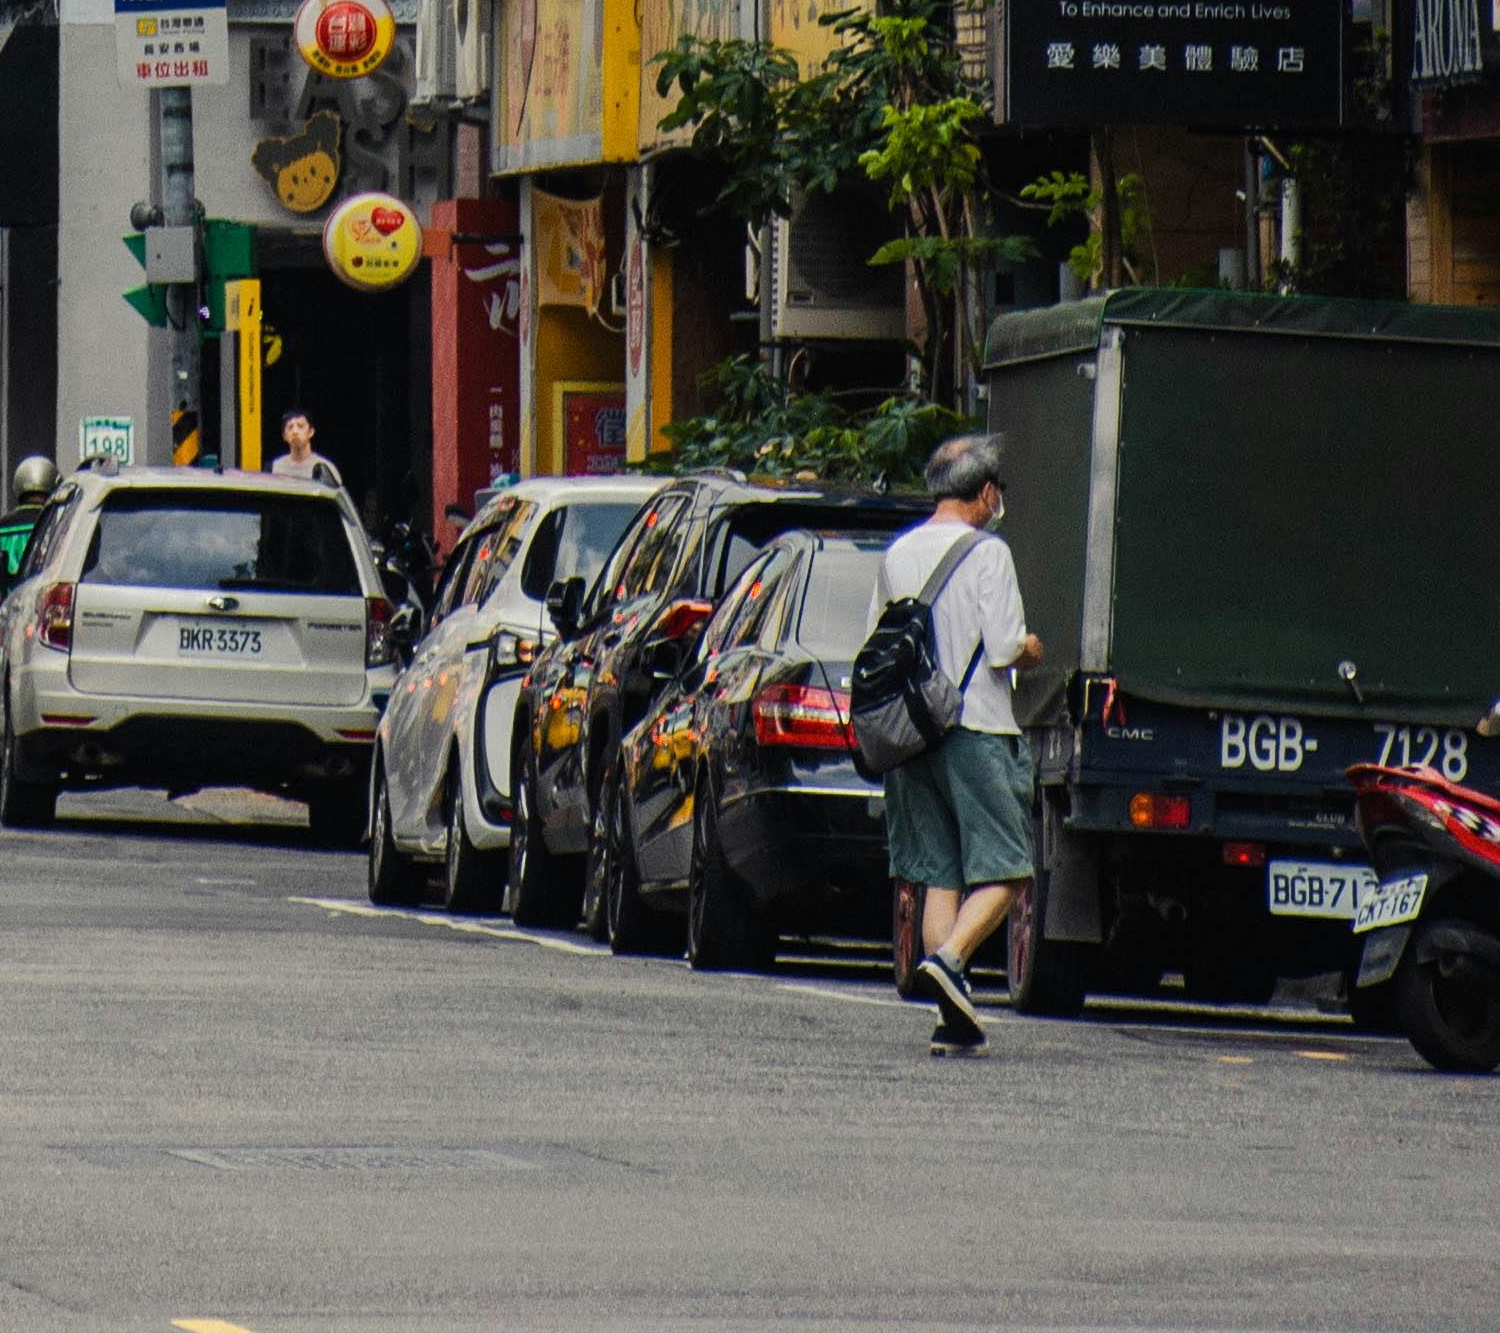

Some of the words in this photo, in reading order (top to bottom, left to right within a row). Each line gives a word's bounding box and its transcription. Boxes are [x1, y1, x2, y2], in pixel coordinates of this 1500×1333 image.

[1059, 0, 1079, 18] To
[1082, 1, 1155, 19] Enhance
[1157, 0, 1191, 19] and
[1194, 0, 1246, 20] Enrich
[1251, 2, 1291, 21] Lives
[1046, 42, 1305, 73] 愛樂美體驗店
[1107, 726, 1155, 741] CMC
[1219, 714, 1319, 771] BGB-
[1371, 724, 1466, 782] 7128
